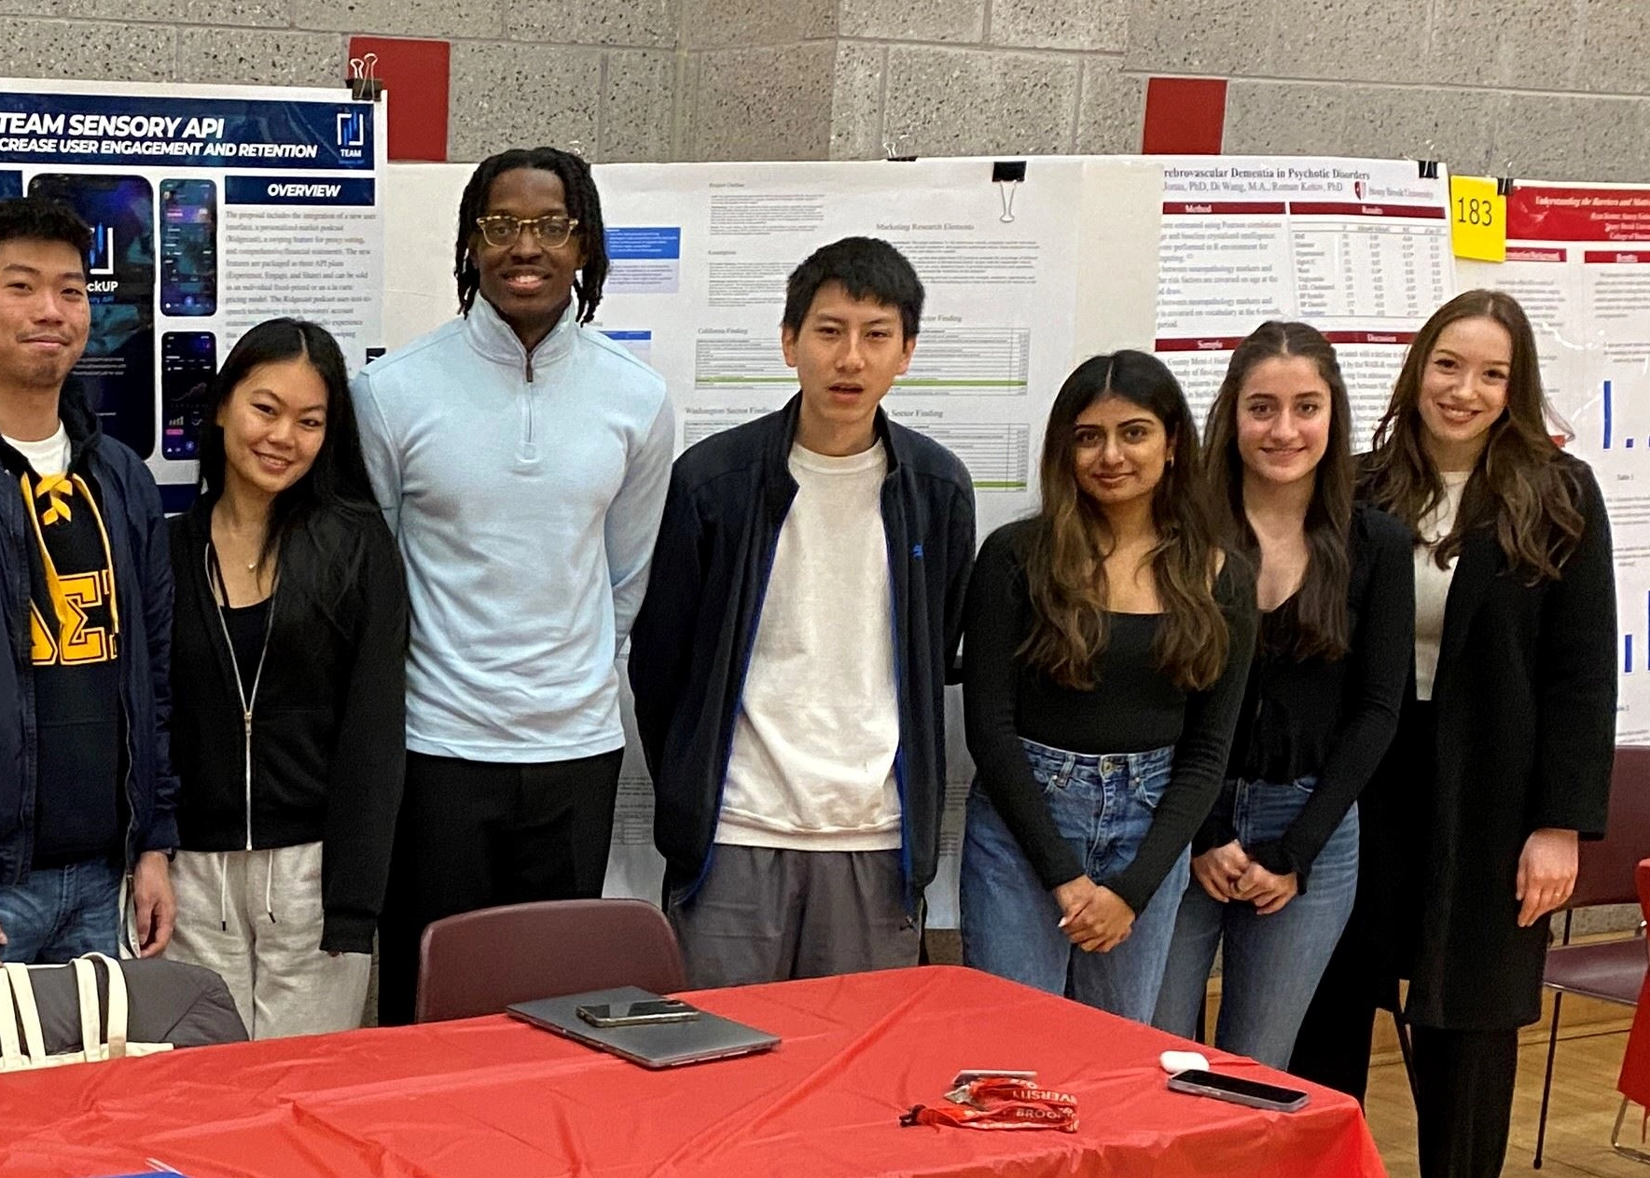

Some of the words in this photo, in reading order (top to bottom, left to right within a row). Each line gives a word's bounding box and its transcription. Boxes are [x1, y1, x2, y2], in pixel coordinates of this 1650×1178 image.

[68, 114, 183, 139] SENSORY
[182, 117, 225, 140] API
[59, 139, 100, 154] USER
[101, 141, 204, 157] ENGAGEMENT
[204, 142, 237, 157] AND
[239, 143, 318, 159] RETENTION
[340, 148, 362, 158] TEAM
[1231, 168, 1275, 179] Dementia
[1276, 168, 1286, 179] in
[1288, 168, 1330, 181] Psychotic
[1332, 169, 1370, 181] Disorders
[267, 183, 341, 198] OVERVIEW
[1457, 197, 1493, 227] 183
[876, 223, 911, 232] Marketing
[912, 223, 943, 231] Research
[943, 223, 975, 231] Elements
[937, 315, 962, 324] Finding
[892, 410, 915, 418] Sector
[915, 409, 944, 419] Finding
